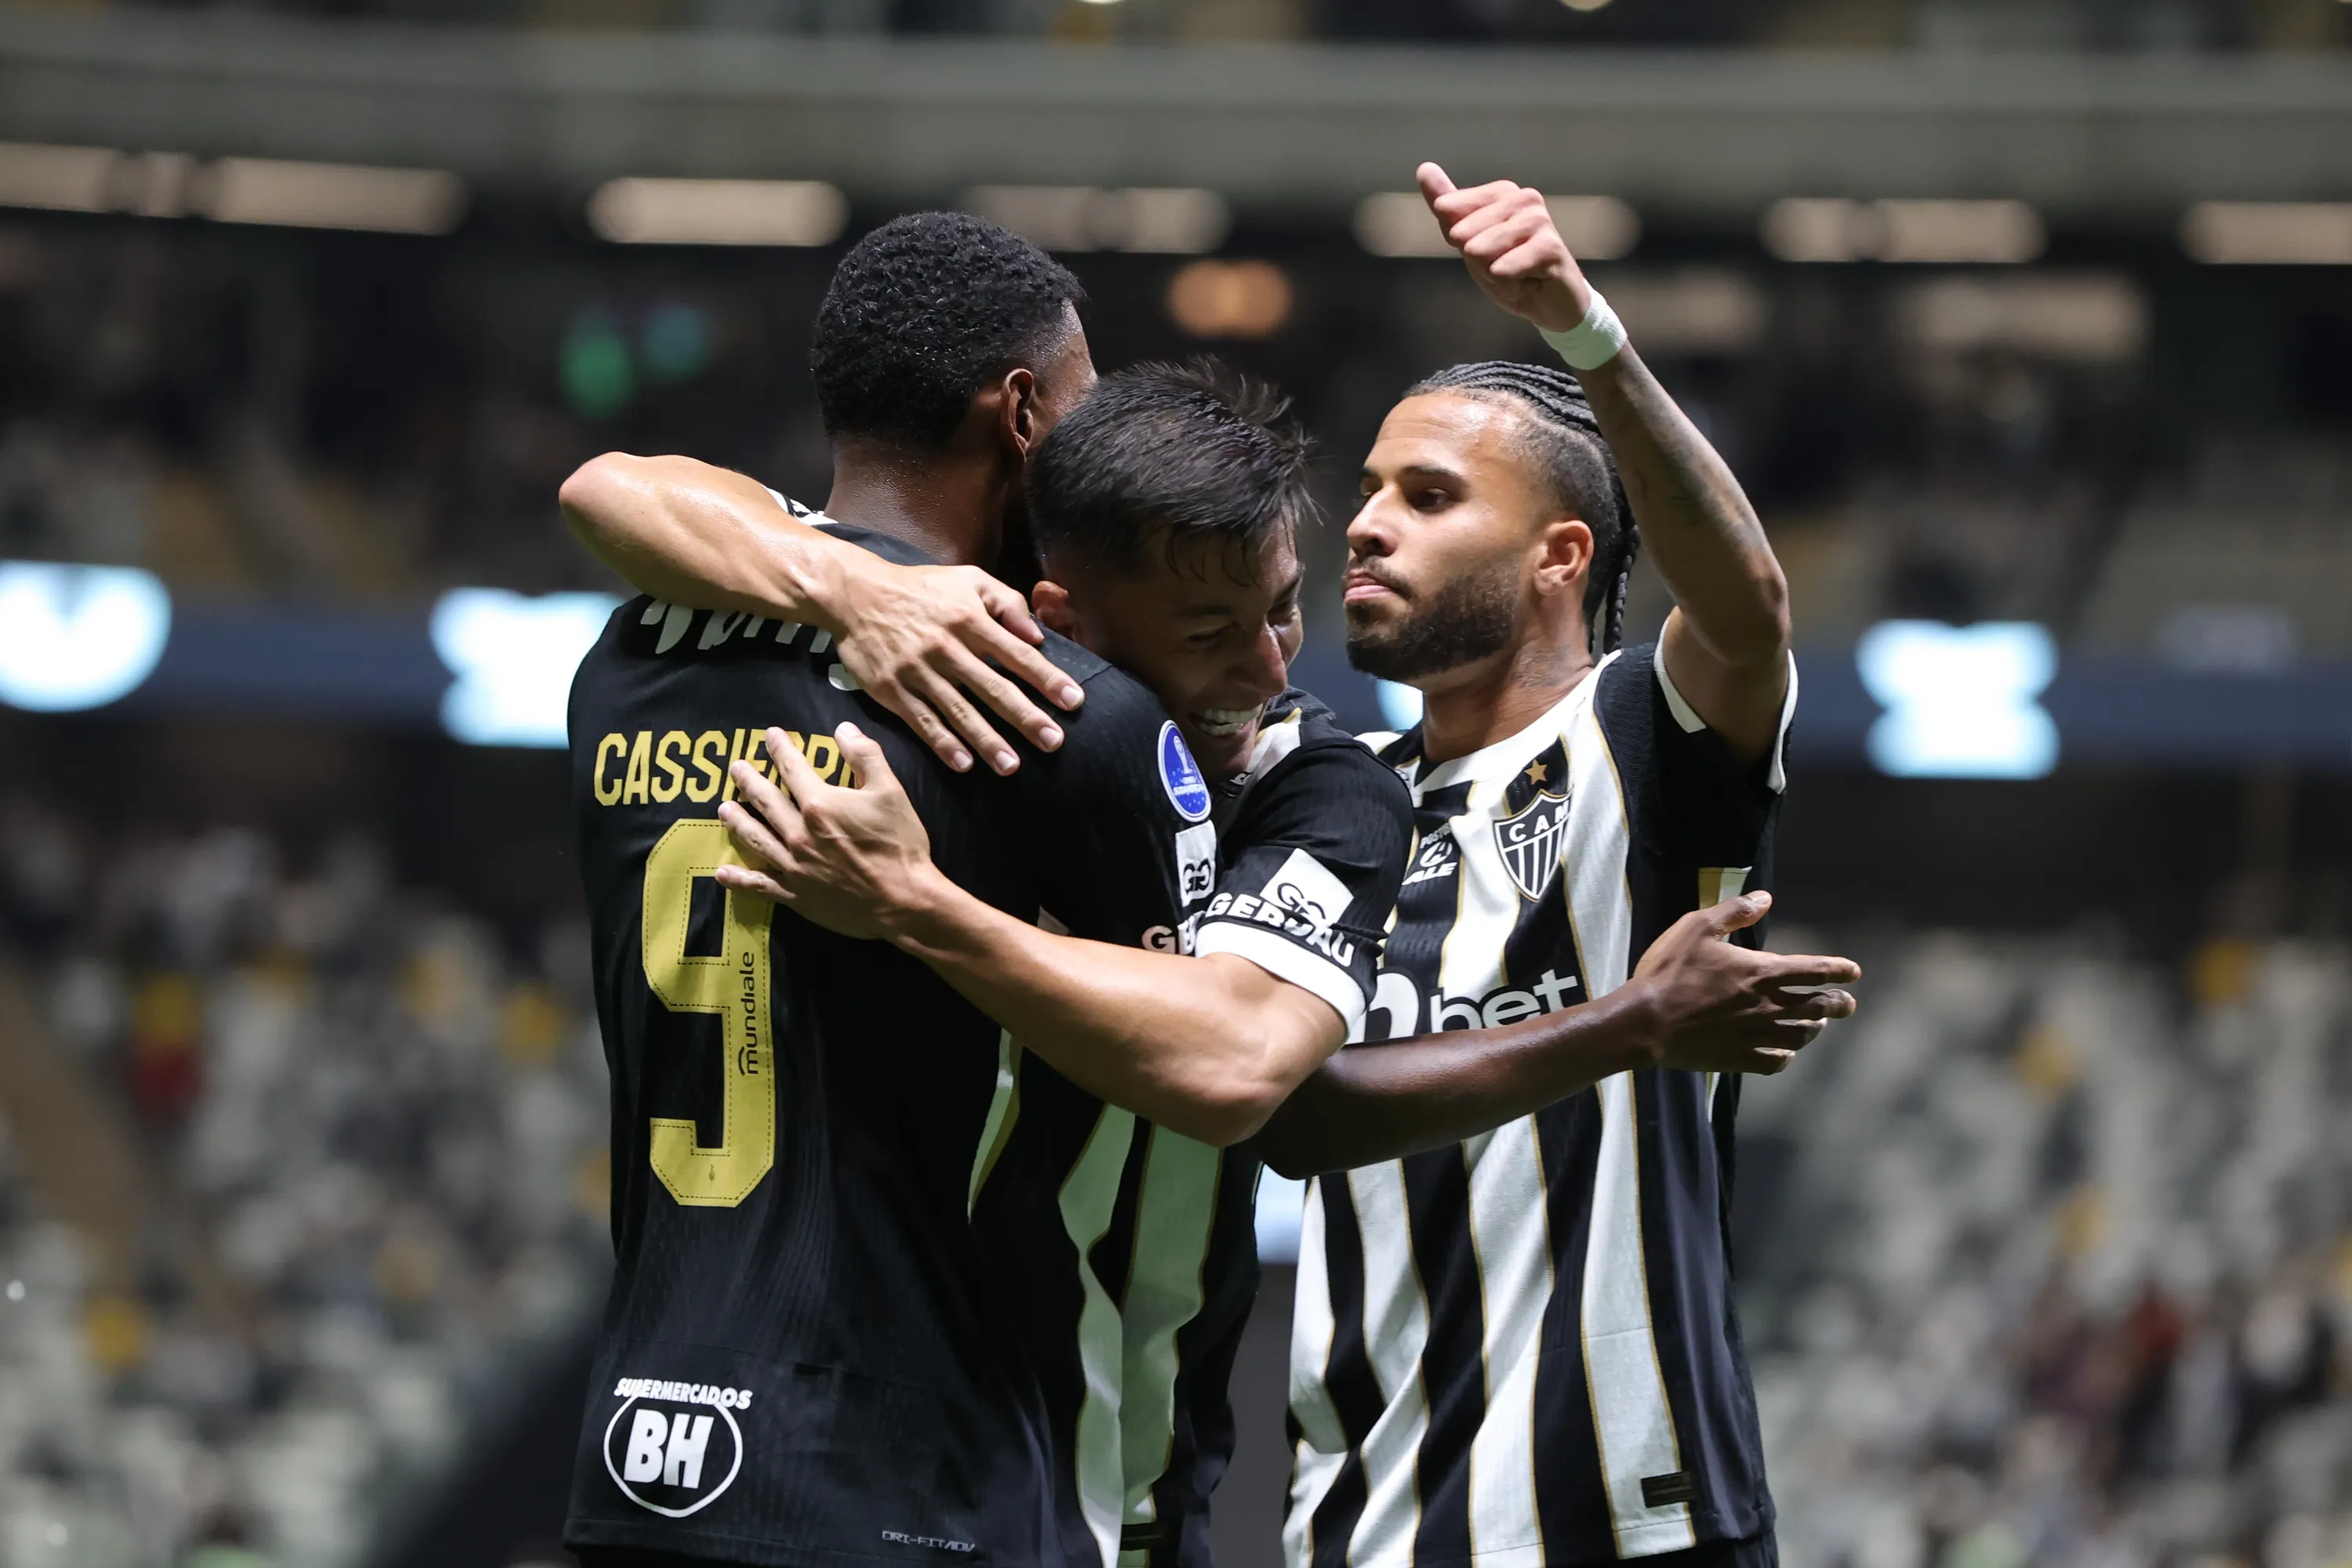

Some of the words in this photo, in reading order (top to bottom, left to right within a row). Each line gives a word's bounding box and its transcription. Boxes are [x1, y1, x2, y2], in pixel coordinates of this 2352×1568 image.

[1509, 800, 1570, 842] CAM
[642, 818, 775, 1207] 9
[738, 951, 759, 1076] mundiale
[614, 1377, 753, 1410] SUPERMERCADOS
[623, 1409, 714, 1489] BH
